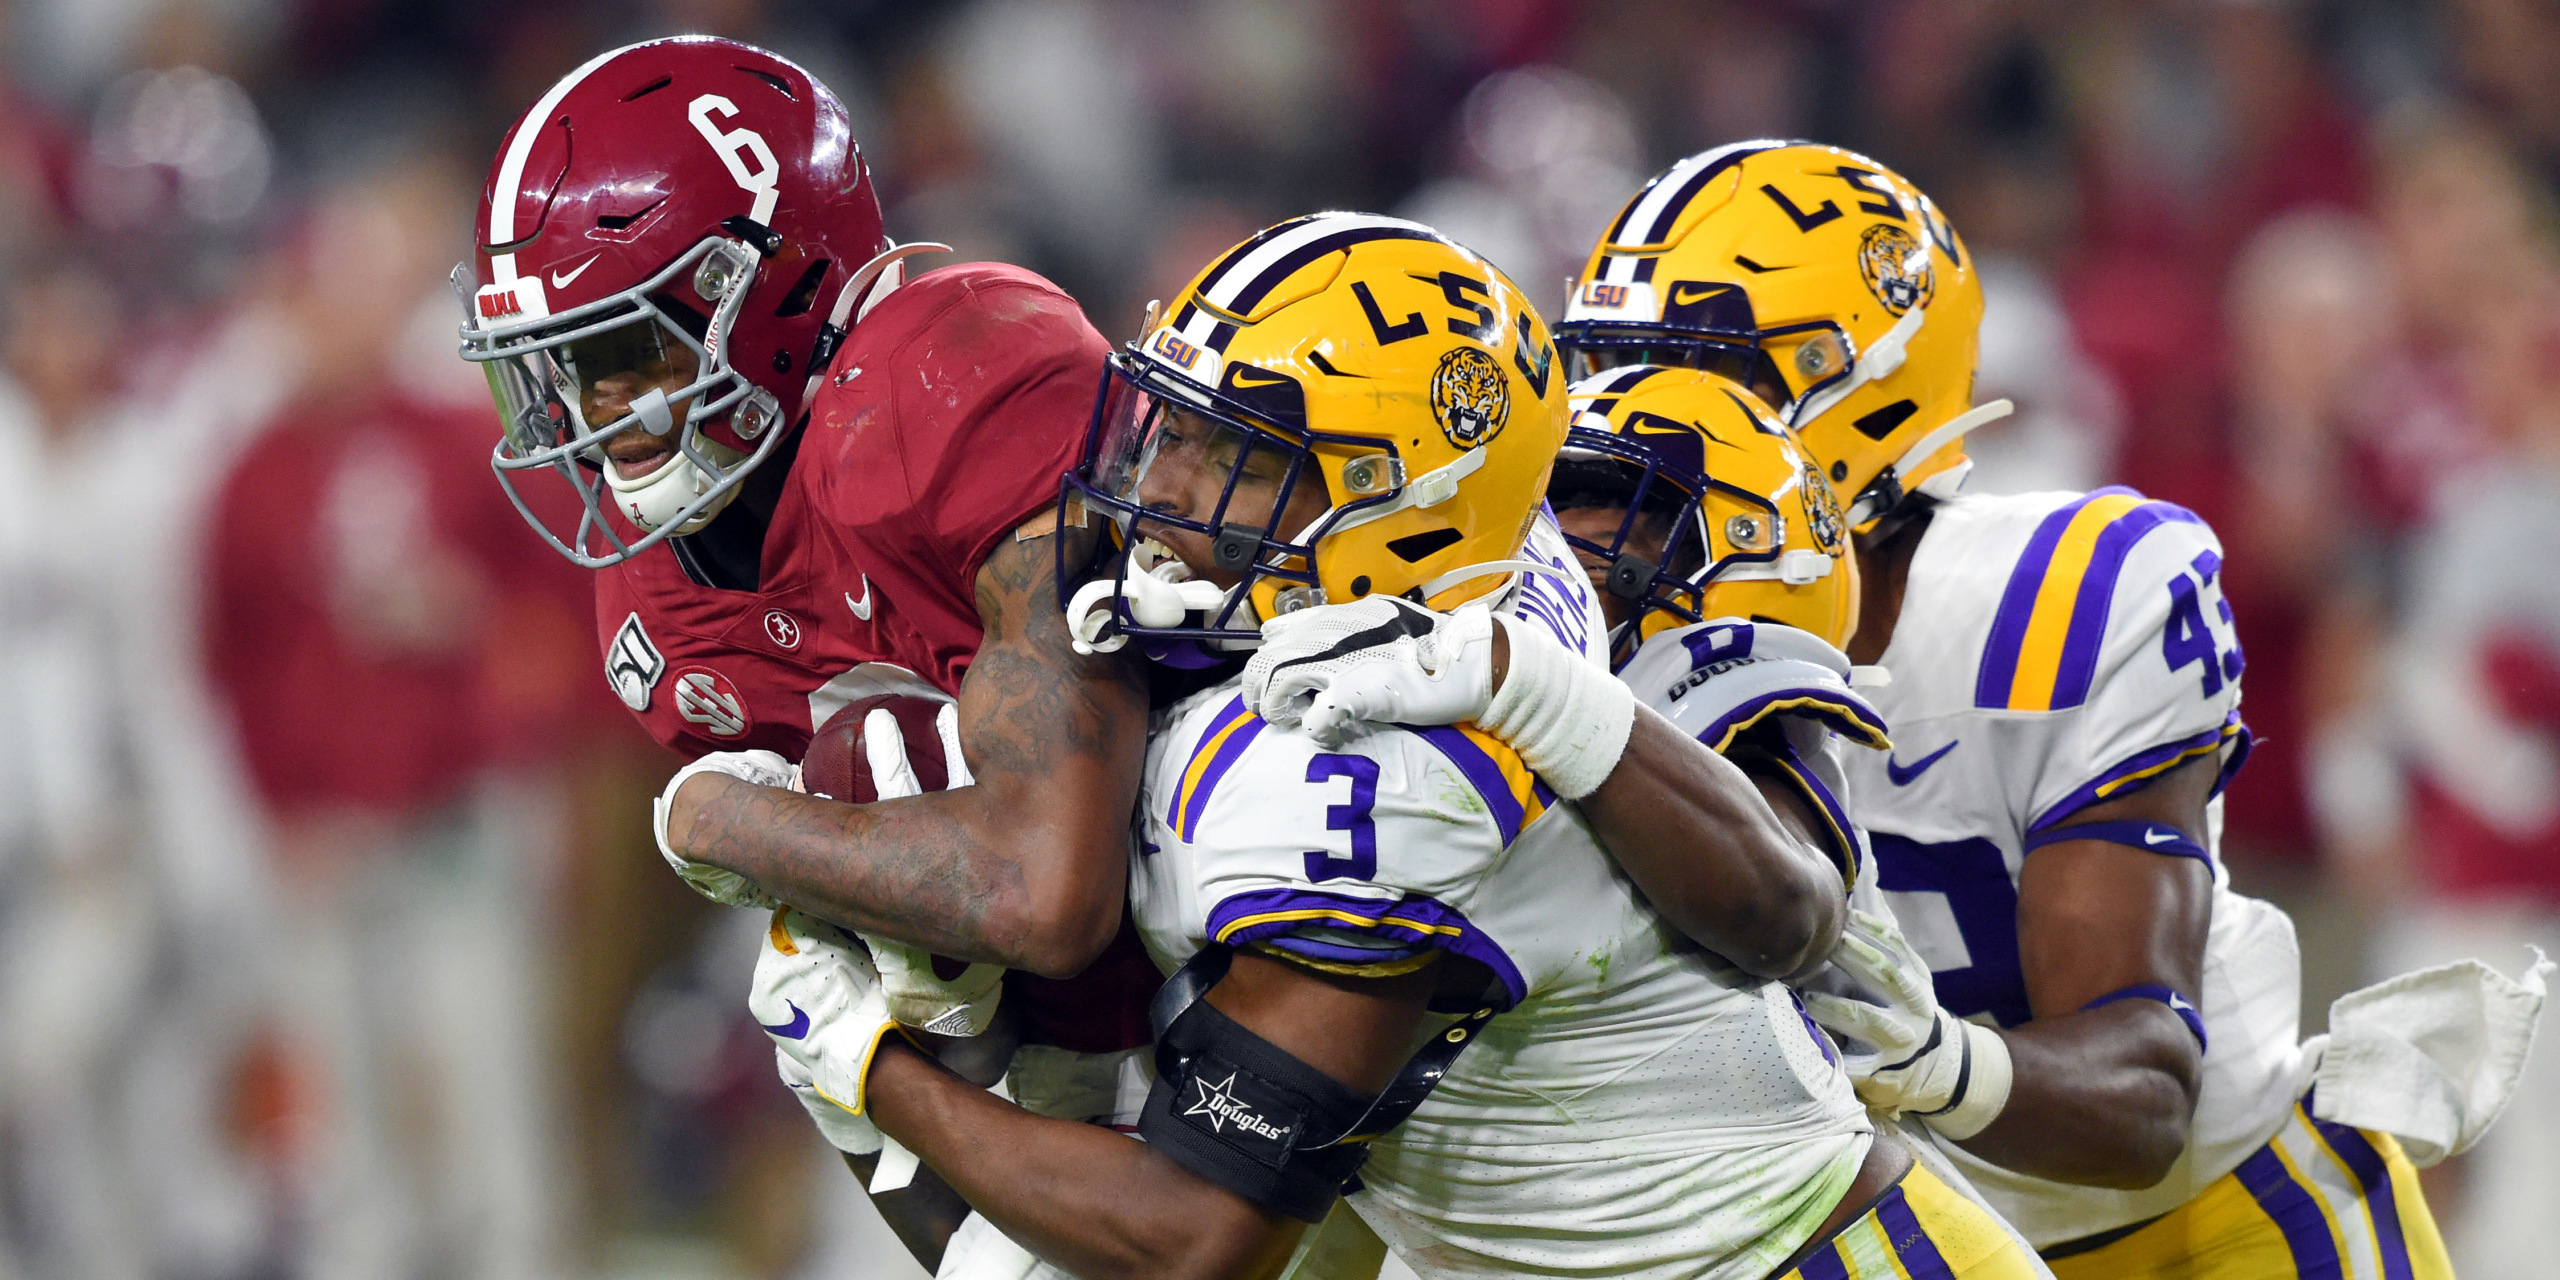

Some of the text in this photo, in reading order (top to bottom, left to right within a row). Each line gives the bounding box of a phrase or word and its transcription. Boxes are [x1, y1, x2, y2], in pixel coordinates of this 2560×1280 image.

[688, 93, 780, 192] 6
[1581, 284, 1630, 310] LSU
[1152, 330, 1202, 371] LSU
[1350, 270, 1553, 401] LSU
[629, 502, 652, 527] A
[1304, 753, 1379, 884] 3
